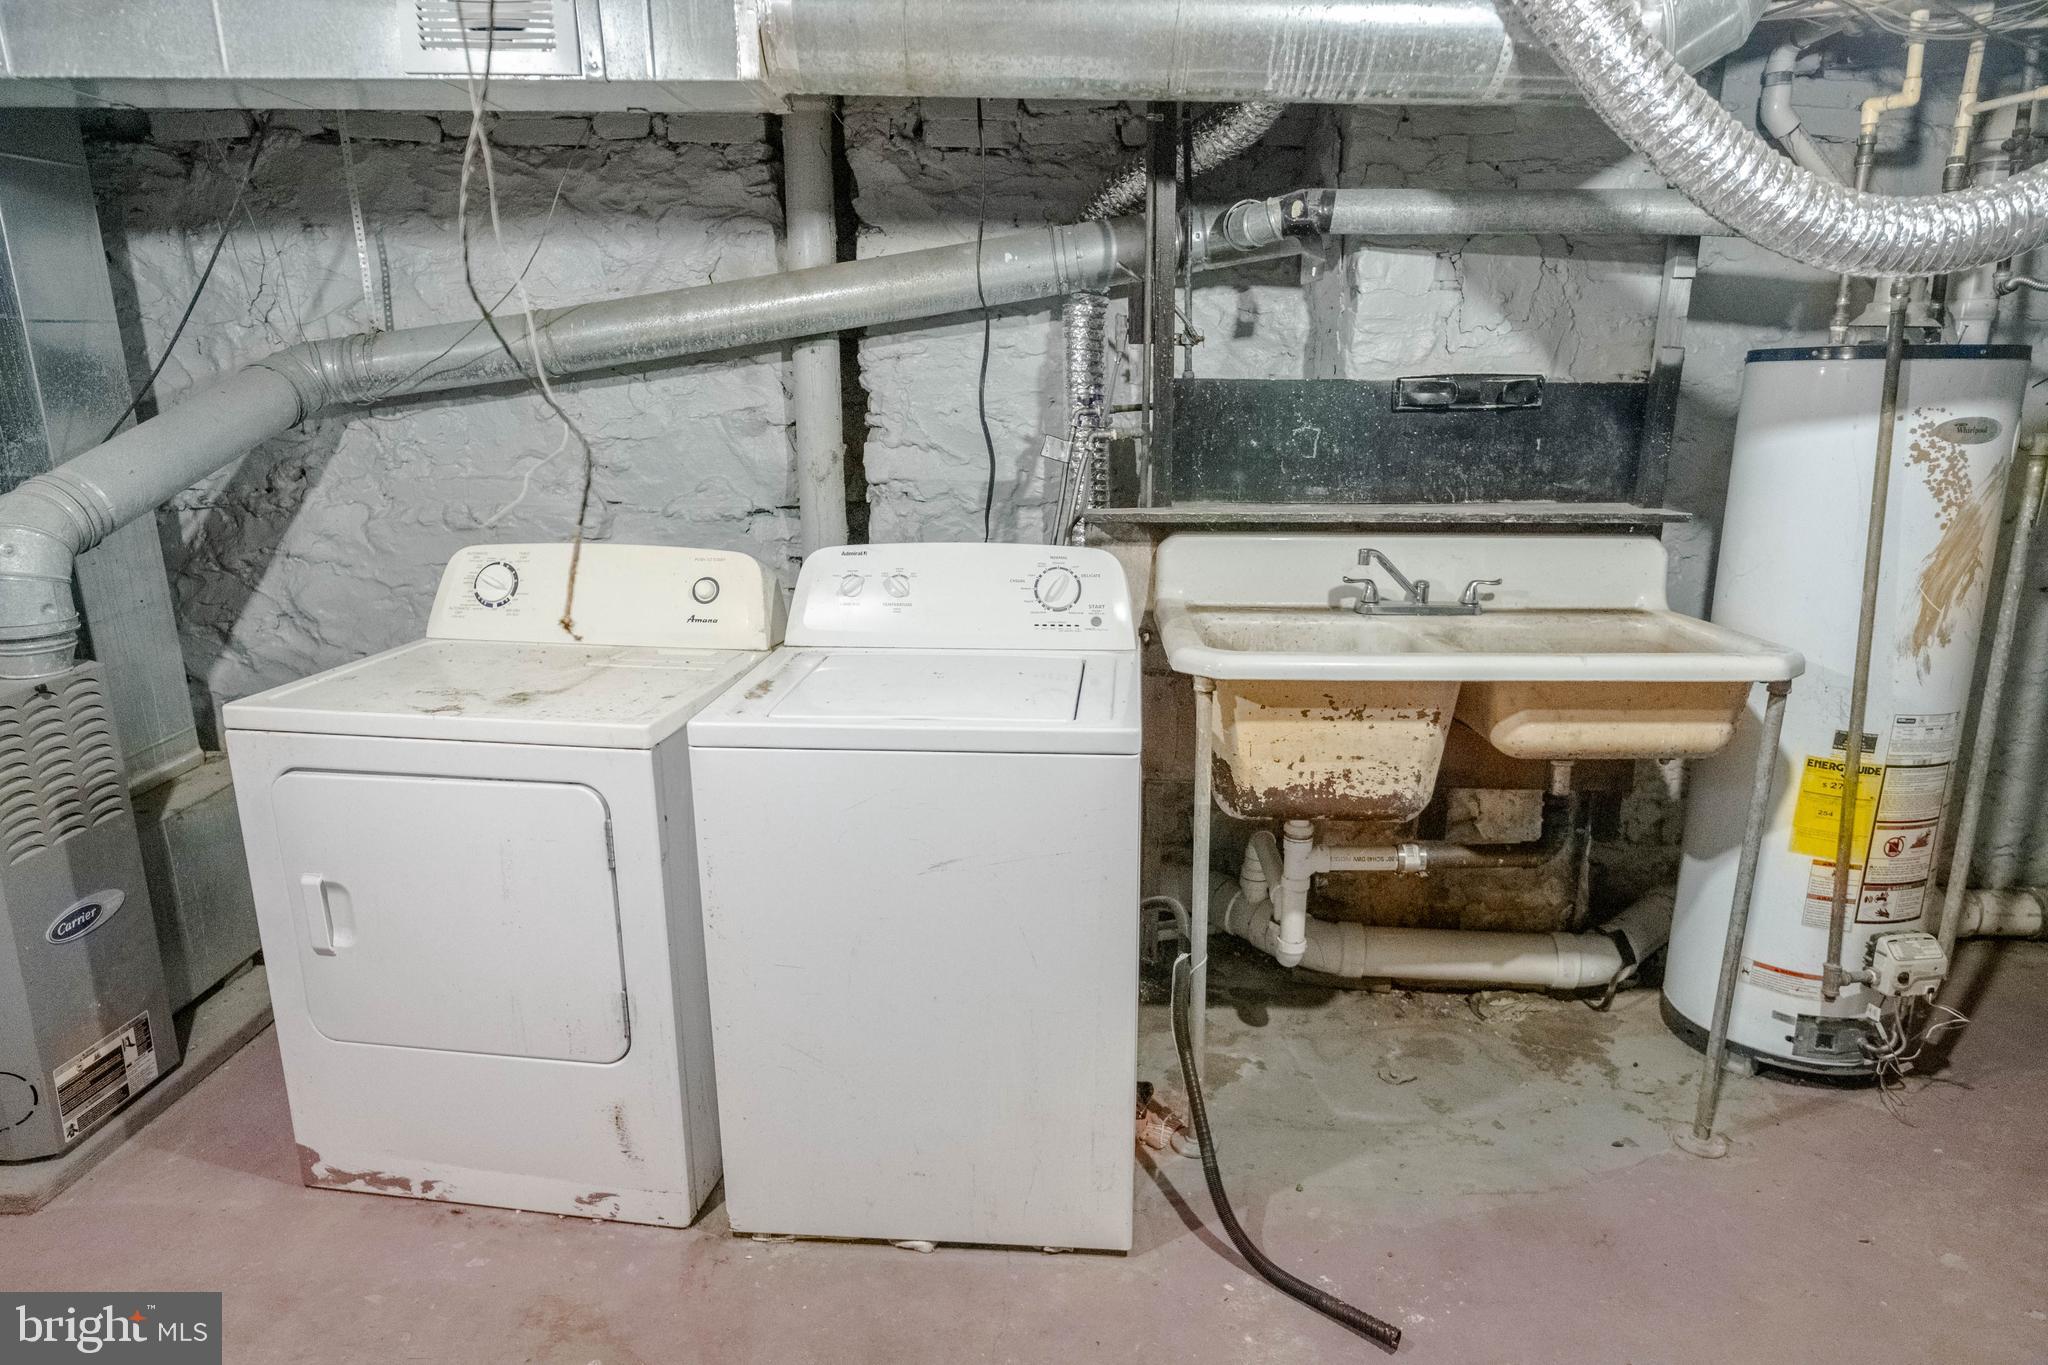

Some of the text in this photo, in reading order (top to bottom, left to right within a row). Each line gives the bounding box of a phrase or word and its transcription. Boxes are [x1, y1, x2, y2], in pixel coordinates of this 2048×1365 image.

[1957, 426, 1988, 435] Whirlpool
[686, 614, 719, 624] Amana
[57, 908, 97, 936] Carrier
